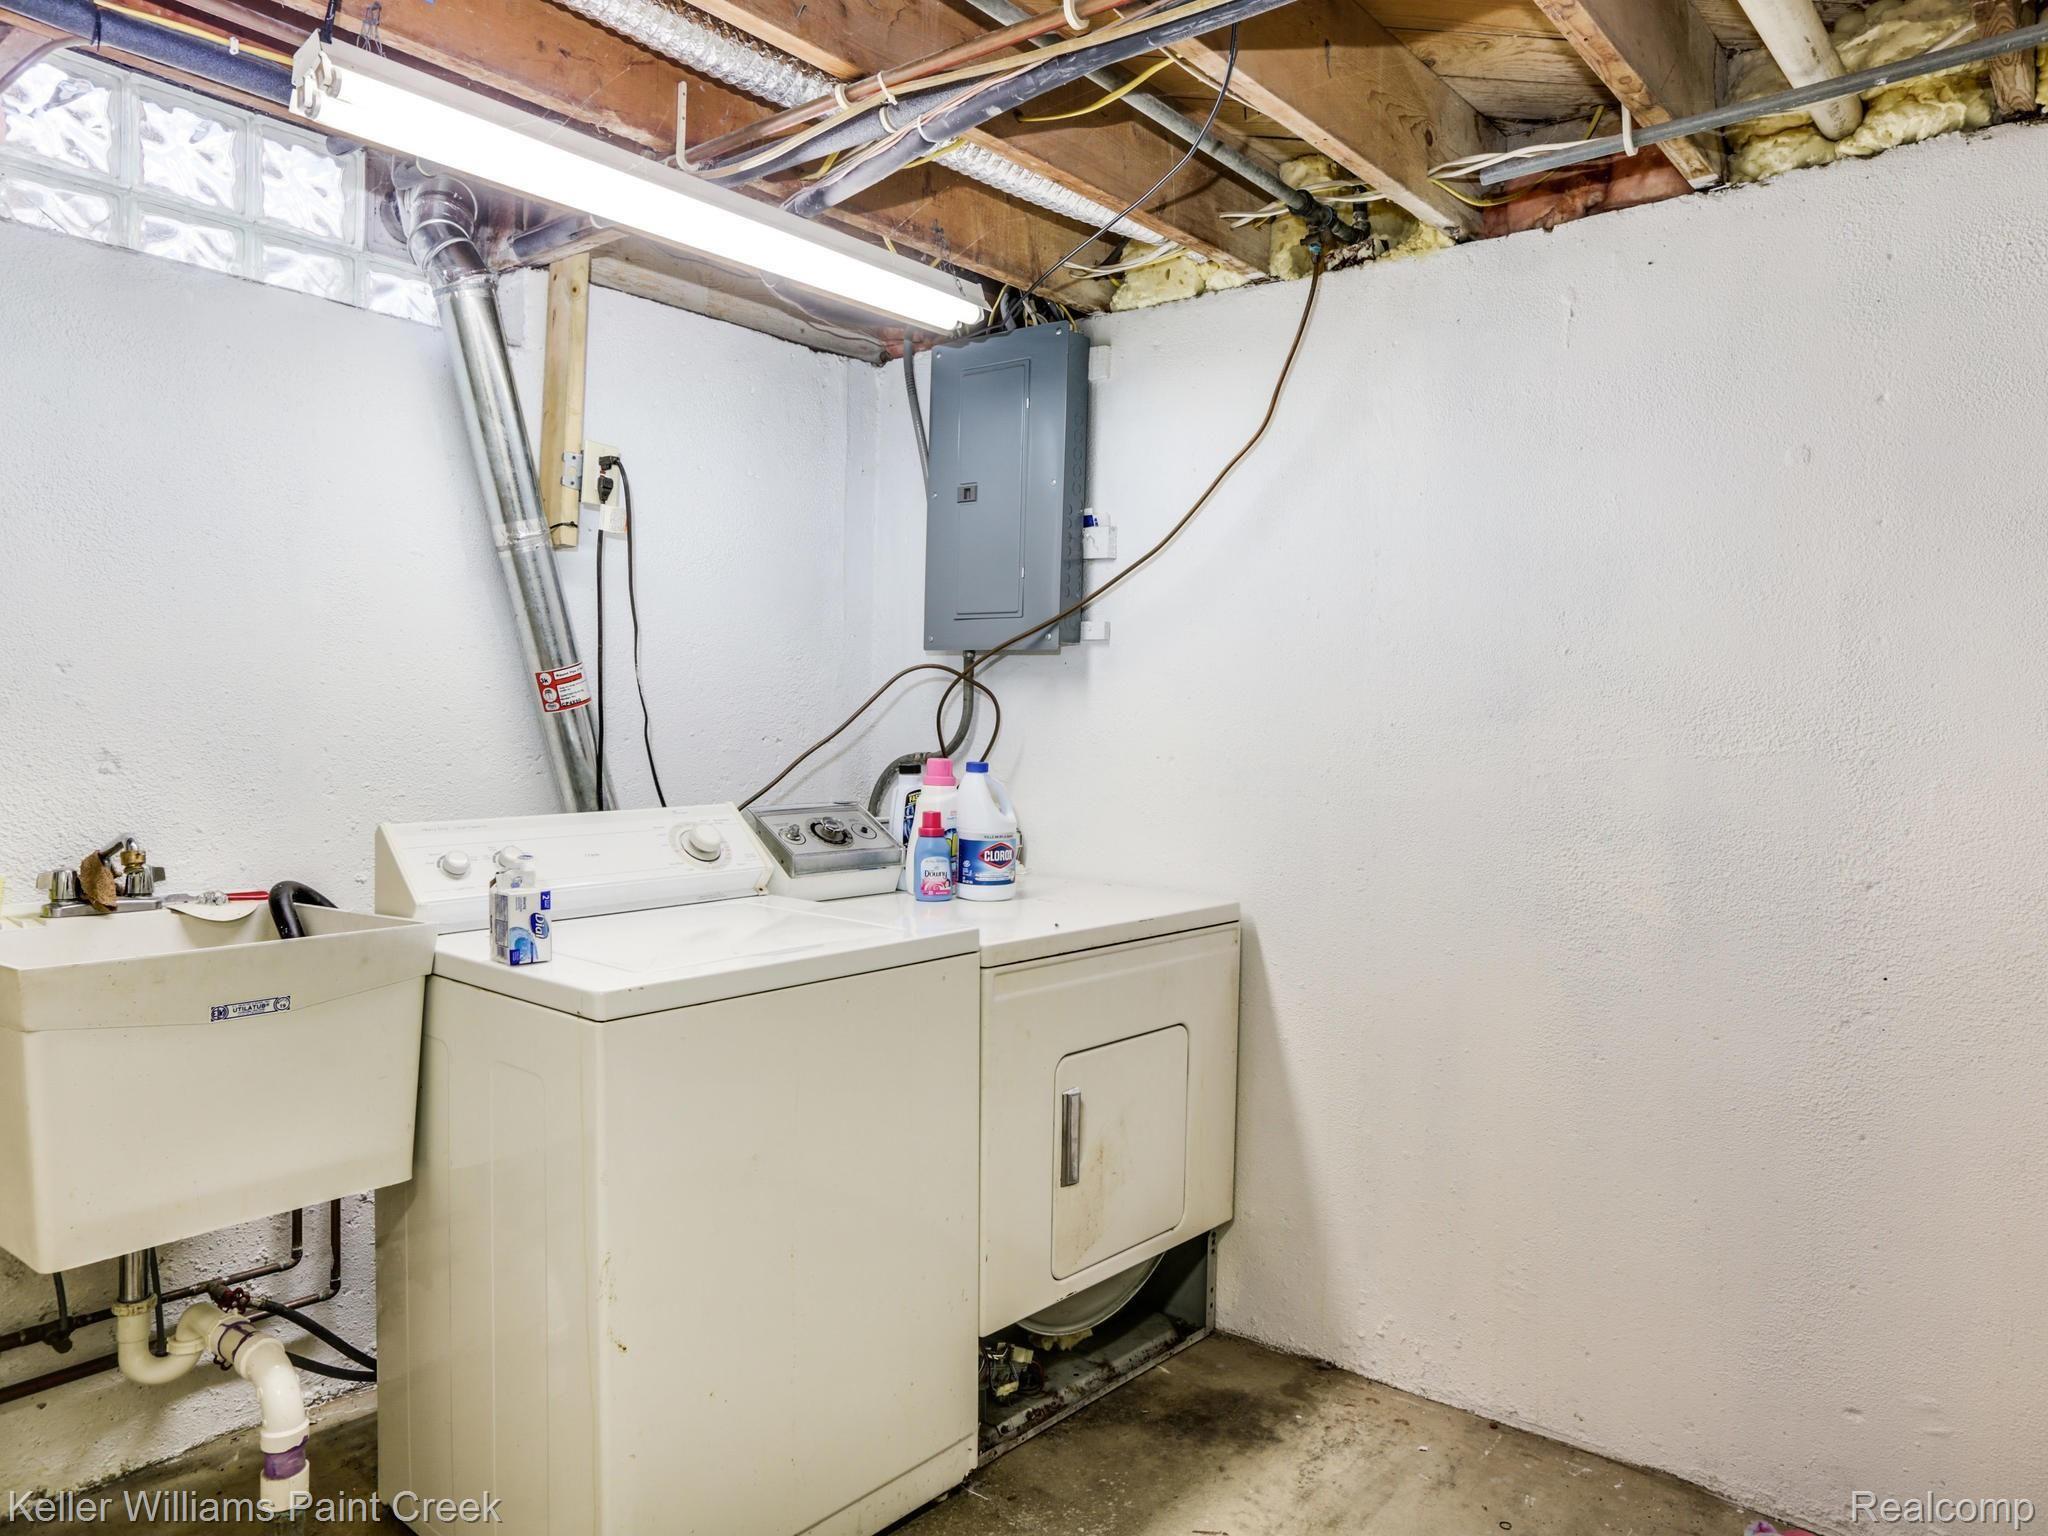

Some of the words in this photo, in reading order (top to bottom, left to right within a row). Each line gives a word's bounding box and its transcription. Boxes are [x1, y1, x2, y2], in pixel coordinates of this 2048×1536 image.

[984, 849, 1013, 862] CLOROX
[924, 870, 948, 879] Downy
[535, 914, 545, 938] Dial
